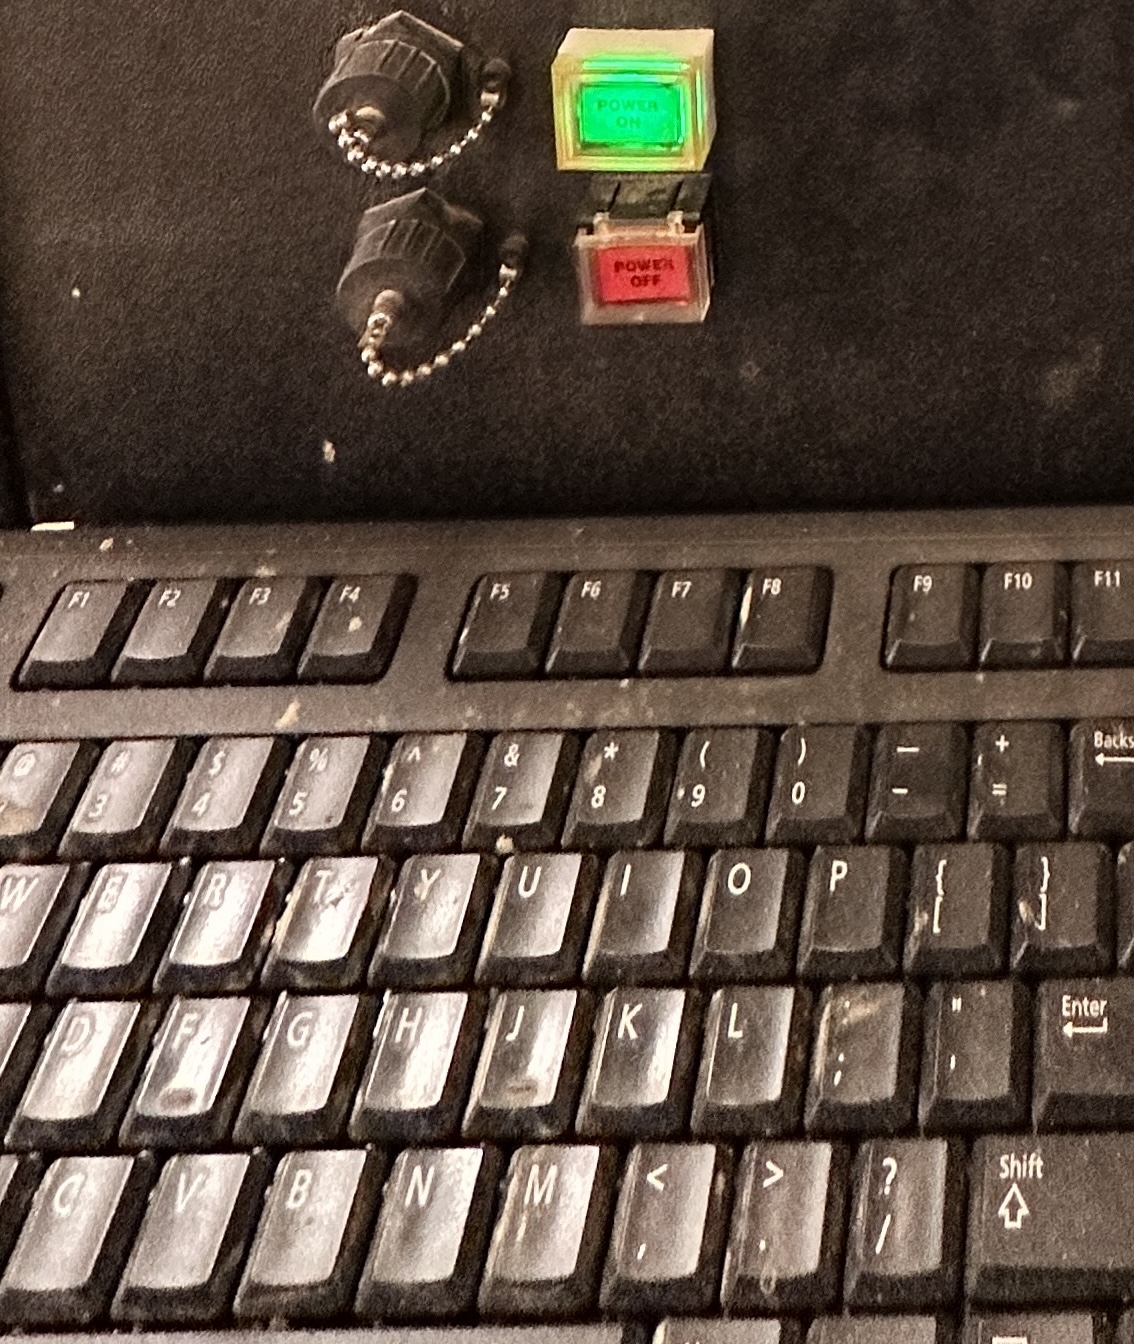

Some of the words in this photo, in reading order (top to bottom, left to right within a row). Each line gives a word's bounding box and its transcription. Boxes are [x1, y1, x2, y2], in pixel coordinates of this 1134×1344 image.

[597, 98, 659, 113] POWER
[615, 115, 642, 130] ON
[613, 257, 675, 274] POWER
[630, 274, 661, 288] OFF
[912, 575, 933, 595] F9
[68, 591, 90, 609] F1
[518, 865, 542, 899] U
[1061, 994, 1108, 1017] Enter
[999, 1153, 1044, 1180] Shift
[404, 1164, 435, 1208] N
